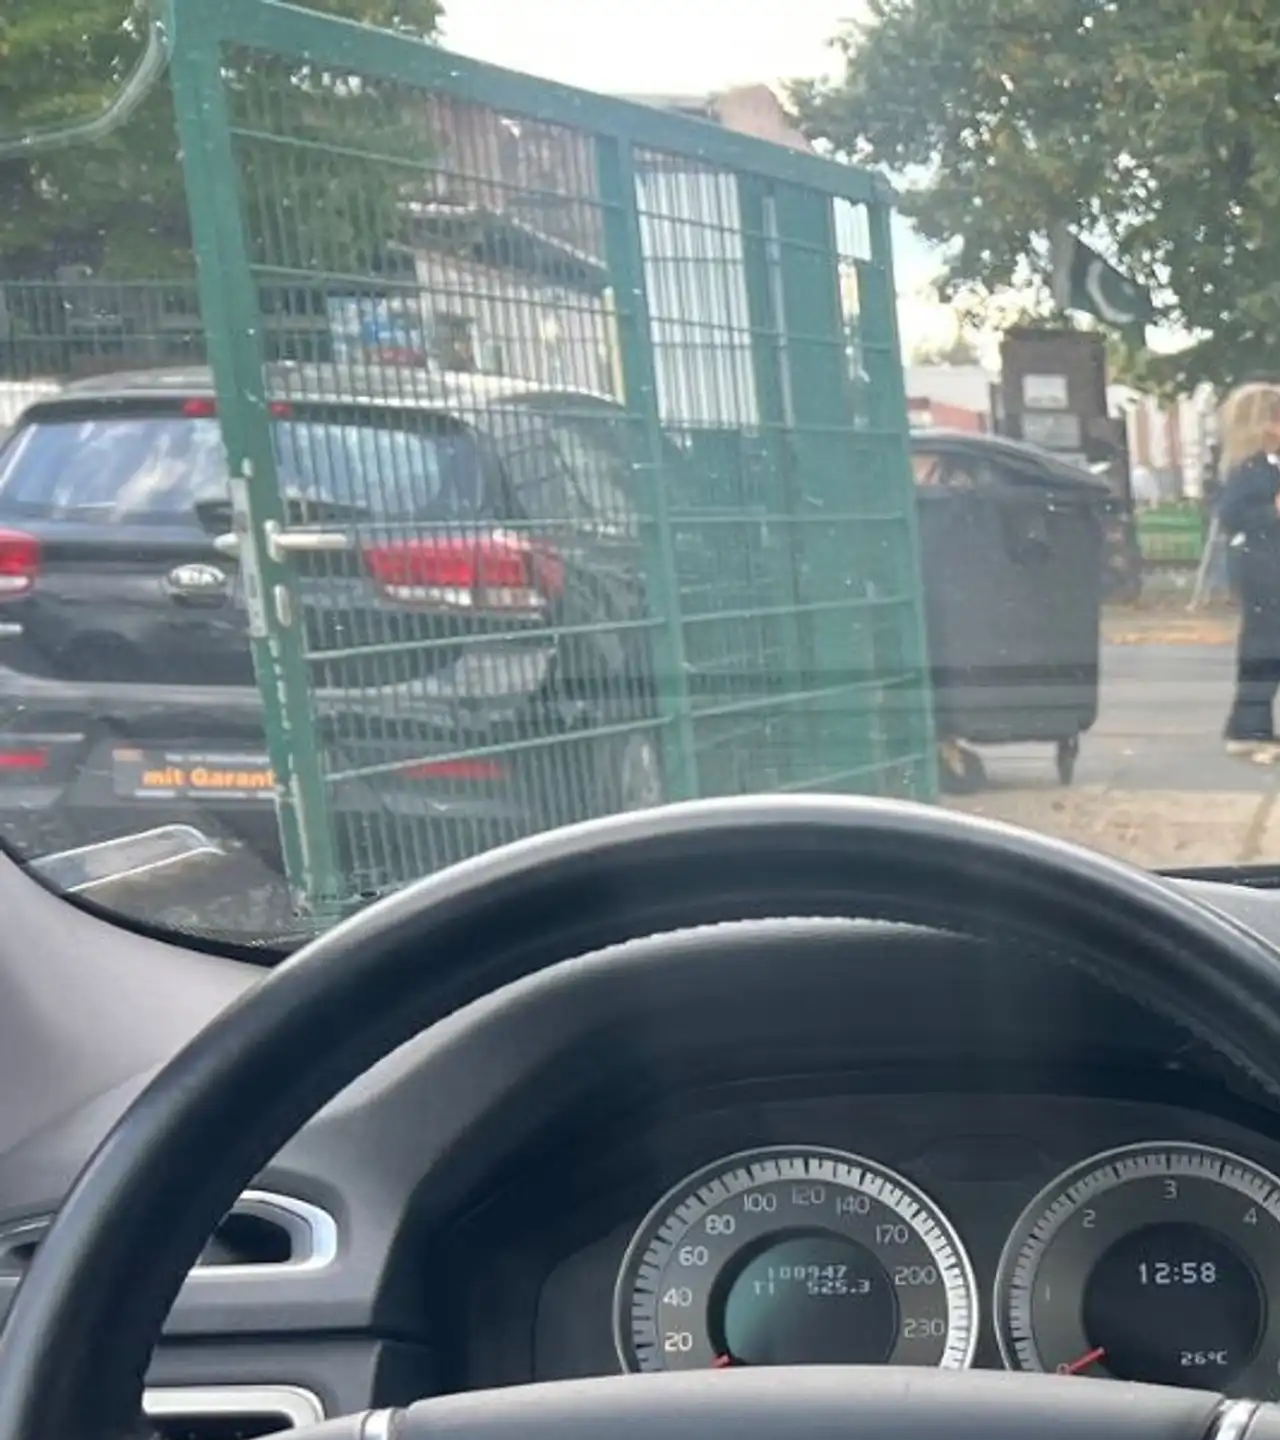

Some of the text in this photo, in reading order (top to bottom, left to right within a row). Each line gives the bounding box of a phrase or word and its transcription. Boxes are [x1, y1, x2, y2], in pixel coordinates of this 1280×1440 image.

[142, 767, 182, 787] mit
[792, 1186, 825, 1205] 120
[1163, 1180, 1177, 1200] 3
[743, 1193, 777, 1212] 100
[835, 1196, 870, 1216] 140
[705, 1215, 735, 1235] 80
[1082, 1209, 1096, 1229] 2
[1243, 1207, 1258, 1225] 4
[875, 1224, 909, 1245] 170
[679, 1246, 708, 1266] 60
[894, 1266, 937, 1286] 200
[1138, 1261, 1217, 1285] 12:58
[663, 1287, 692, 1307] 40
[904, 1319, 945, 1338] 230
[664, 1332, 693, 1351] 20
